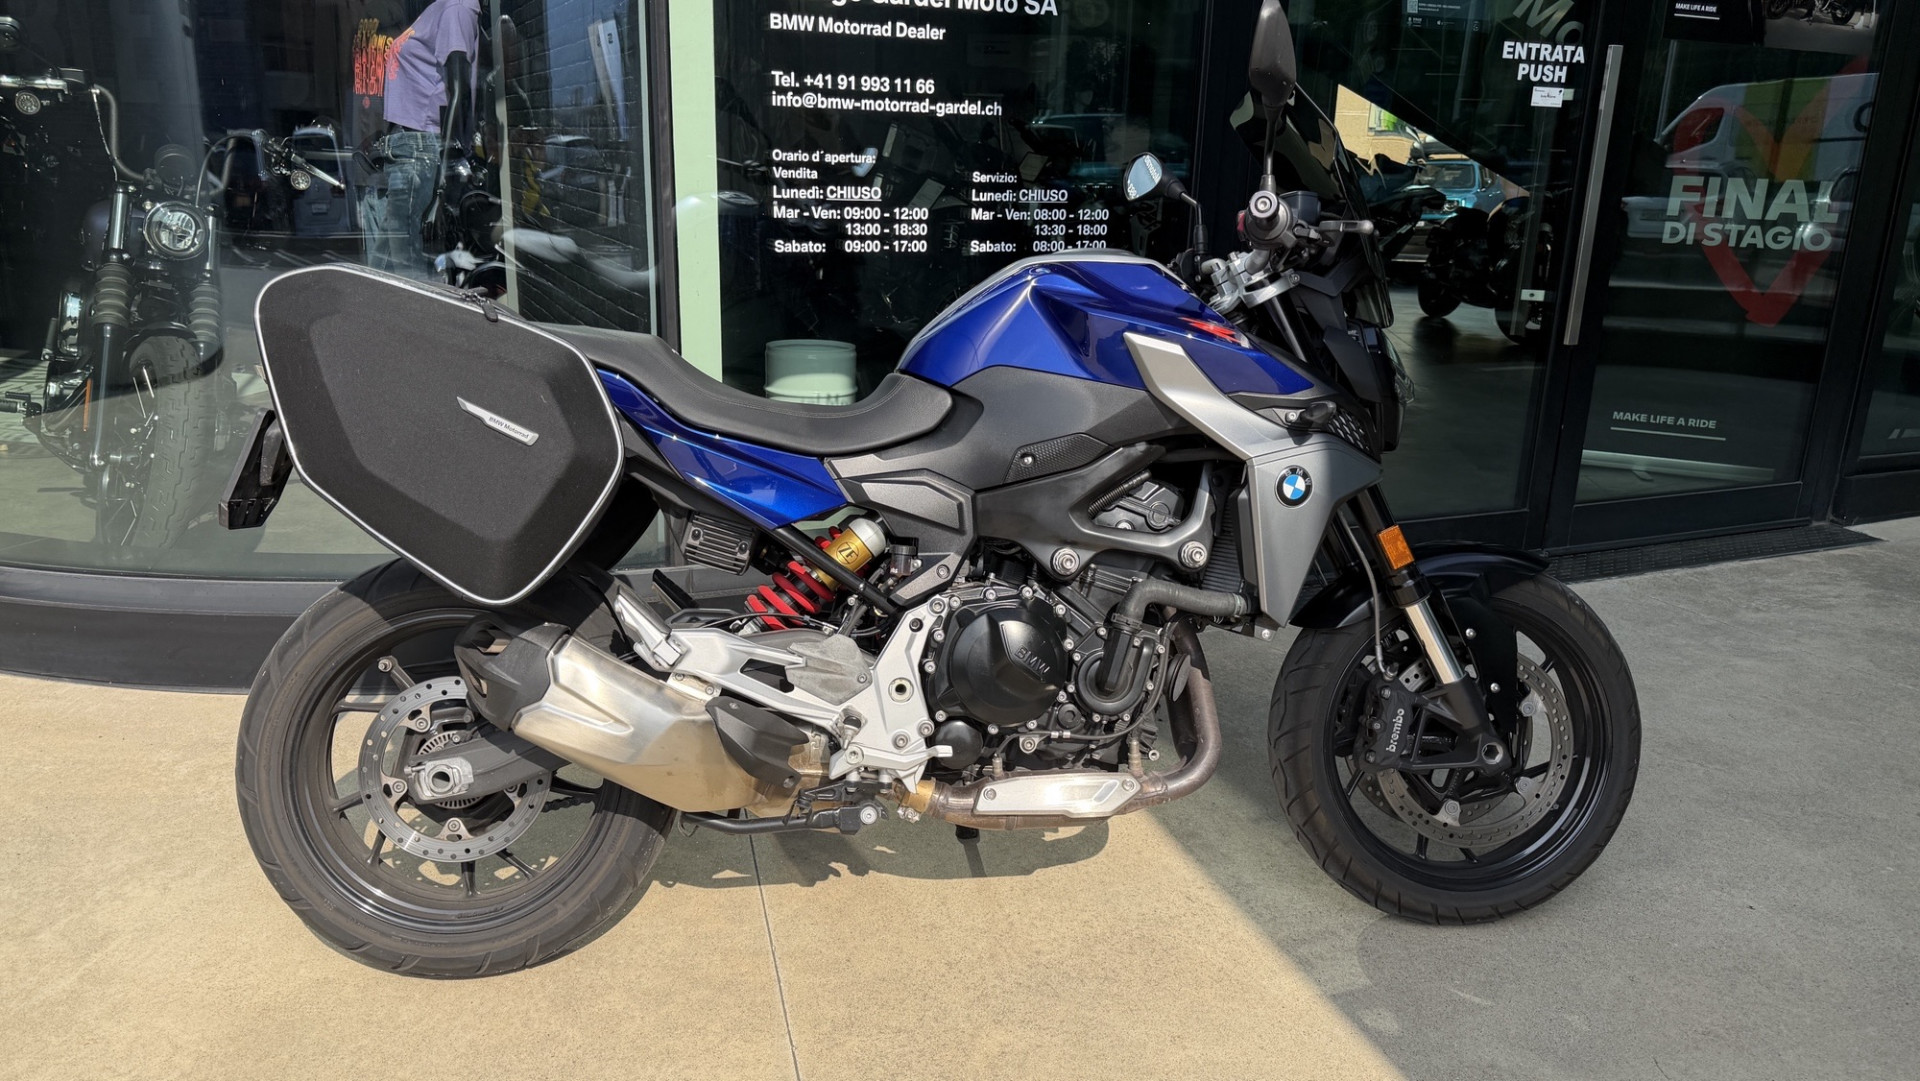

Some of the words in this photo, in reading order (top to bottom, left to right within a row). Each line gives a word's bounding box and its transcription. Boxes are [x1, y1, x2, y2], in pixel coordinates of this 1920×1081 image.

[769, 12, 815, 32] BMW
[818, 16, 892, 38] Motorrad
[895, 22, 946, 41] Dealer
[1501, 40, 1585, 64] ENTRATA
[771, 70, 800, 88] Tel.
[803, 73, 832, 89] +41
[837, 74, 856, 90] 91
[860, 76, 890, 92] 993
[895, 78, 911, 93] 11
[915, 79, 935, 94] 66
[1516, 62, 1568, 84] PUSH
[771, 91, 1003, 117] info@bmw-motorrad-gardel.ch
[772, 149, 810, 162] Orario
[772, 166, 818, 180] Vendita
[972, 171, 1018, 183] Servizio:
[772, 185, 824, 199] Lunedì:
[826, 185, 882, 201] CHIUSO
[971, 189, 1017, 202] Lunedì:
[1018, 189, 1069, 203] CHIUSO
[1666, 174, 1840, 224] FINAL
[772, 206, 800, 219] Mar
[811, 206, 841, 219] Ven:
[843, 206, 881, 220] 09:00
[893, 207, 929, 220] 12:00
[970, 208, 995, 220] Mar
[1005, 208, 1031, 220] Ven:
[1033, 208, 1067, 220] 08:00
[1077, 208, 1110, 221] 12:00
[845, 223, 881, 236] 13:00
[893, 223, 928, 236] 18:30
[1034, 224, 1066, 236] 13:30
[1076, 224, 1108, 236] 18:00
[1661, 221, 1697, 246] DI
[1701, 223, 1833, 252] STAGIO
[774, 239, 827, 253] Sabato:
[844, 240, 881, 253] 09:00
[892, 240, 928, 253] 17:00
[970, 240, 1017, 253] Sabato:
[1032, 240, 1065, 252] 08:00
[488, 416, 505, 428] BMW
[503, 423, 530, 439] Motorrad
[1612, 411, 1648, 423] MAKE
[1650, 414, 1675, 426] LIFE
[1676, 417, 1686, 427] A
[1688, 418, 1717, 430] RIDE
[1284, 468, 1312, 486] BMW
[837, 542, 859, 564] ZF
[1015, 645, 1050, 674] BMW
[1385, 708, 1405, 753] brembo
